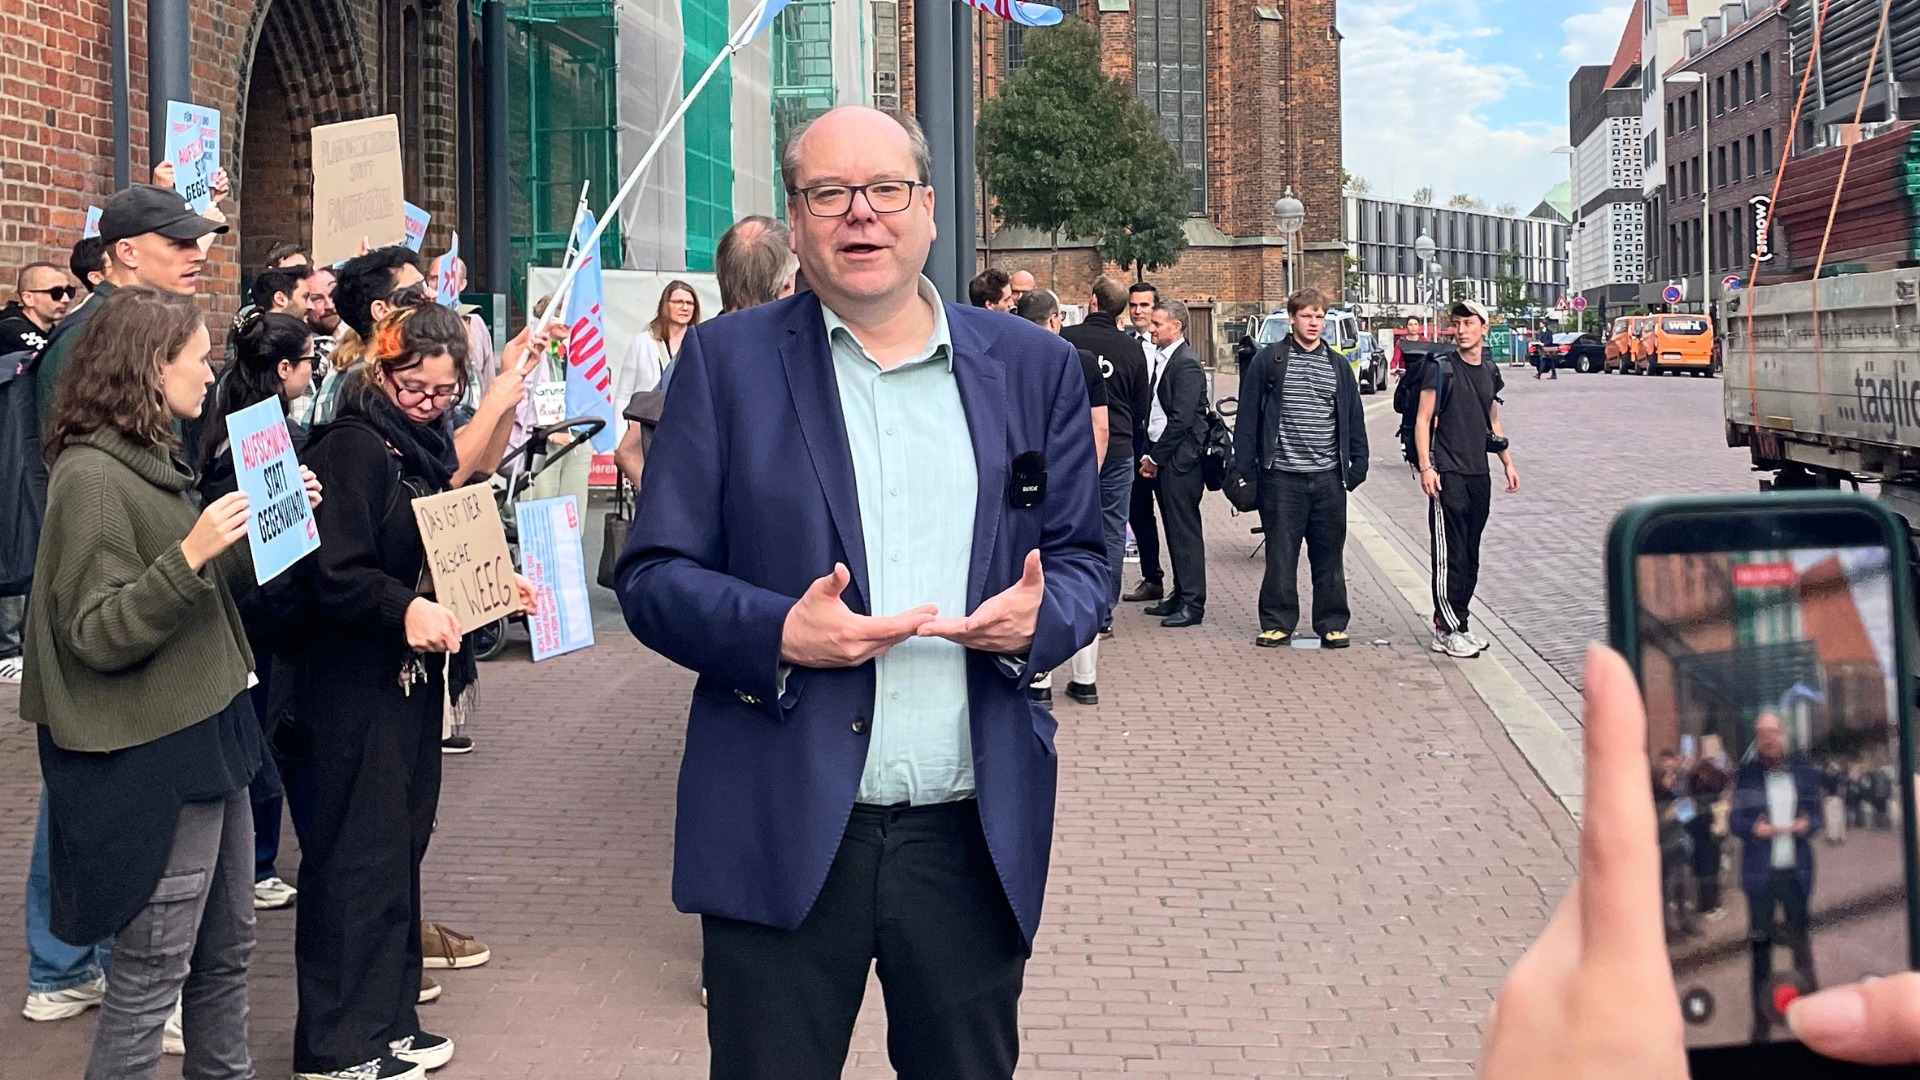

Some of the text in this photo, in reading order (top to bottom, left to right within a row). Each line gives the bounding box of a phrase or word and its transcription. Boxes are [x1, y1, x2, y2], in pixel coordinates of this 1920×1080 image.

[264, 460, 288, 500] STATT
[590, 462, 618, 473] ieren
[257, 488, 308, 544] GEGENWIND!
[421, 493, 482, 540] DAS IST DER
[434, 543, 471, 579] FALSCHE
[460, 555, 511, 616] WEEG
